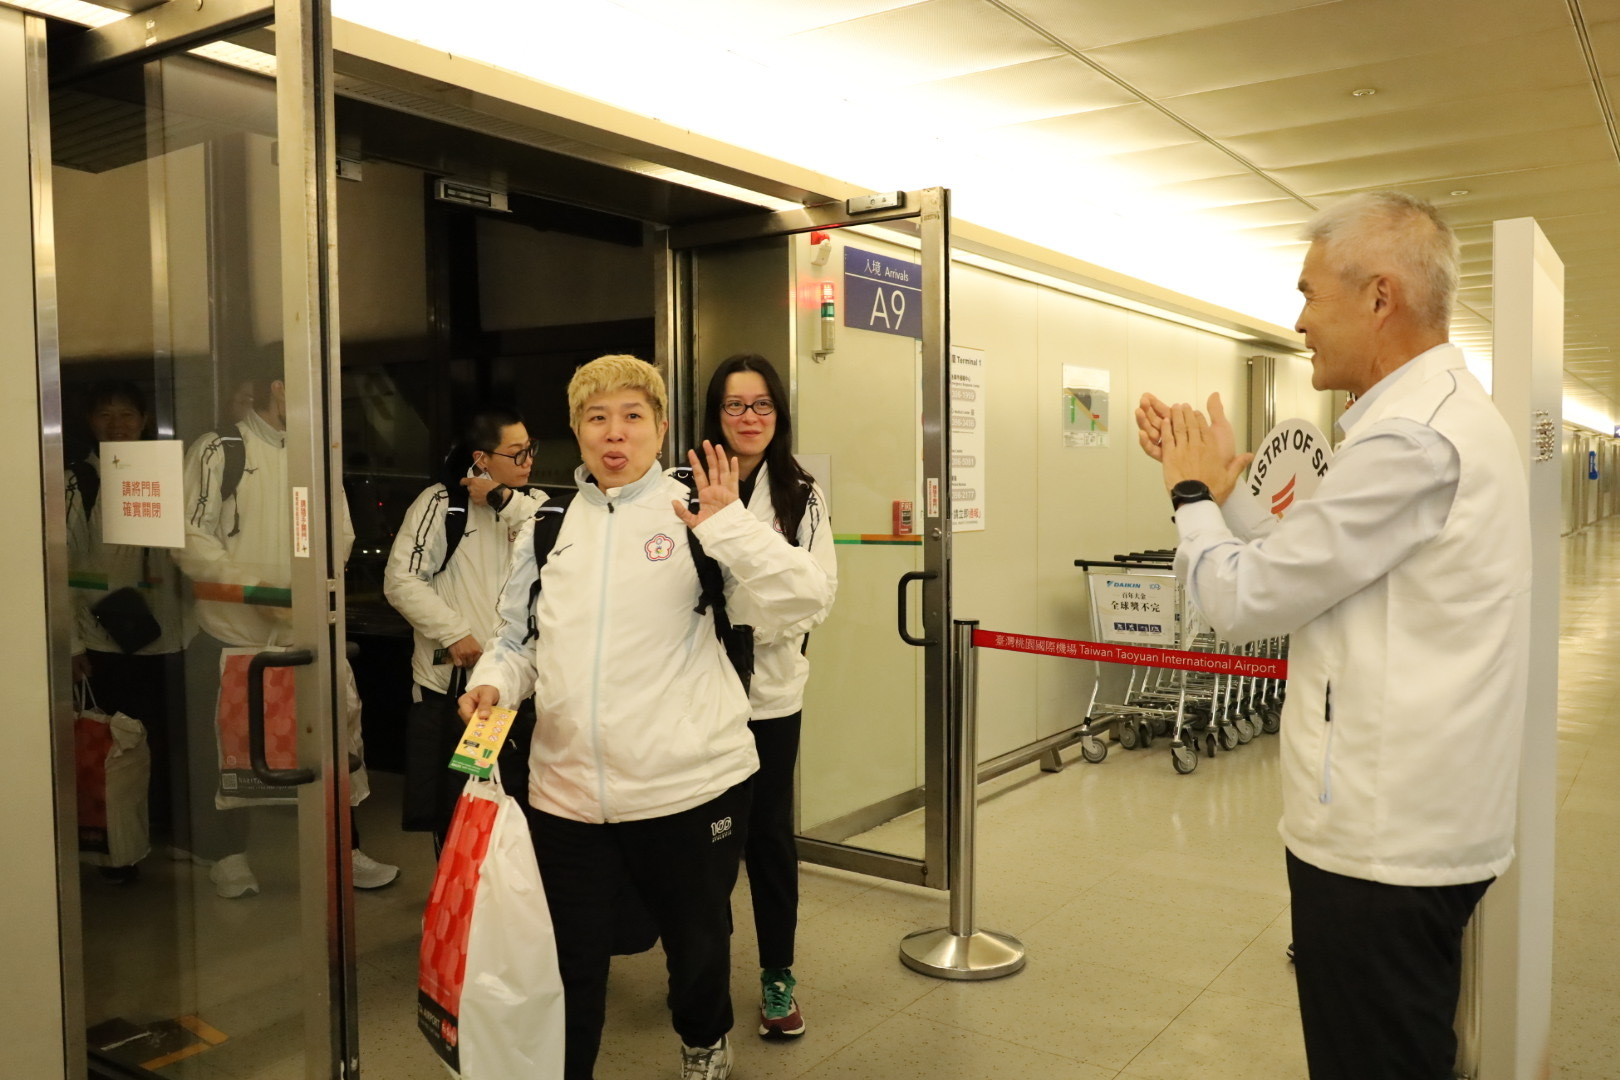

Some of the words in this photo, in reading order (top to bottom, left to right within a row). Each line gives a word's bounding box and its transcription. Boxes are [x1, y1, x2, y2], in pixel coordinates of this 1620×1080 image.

[864, 258, 882, 276] 入境
[884, 266, 909, 282] Arrivals
[869, 286, 906, 330] A9
[957, 356, 978, 366] Terminal
[1293, 428, 1314, 454] OF
[122, 481, 161, 497] 請將門扇
[123, 502, 162, 518] 確實關閉
[1122, 592, 1147, 600] 百年大金
[995, 634, 1077, 655] 臺灣桃園國際機場
[1080, 644, 1114, 658] Taiwan
[1115, 648, 1159, 664] Taoyuan
[1161, 653, 1232, 670] International
[1233, 660, 1277, 675] Airport
[710, 816, 732, 837] 100
